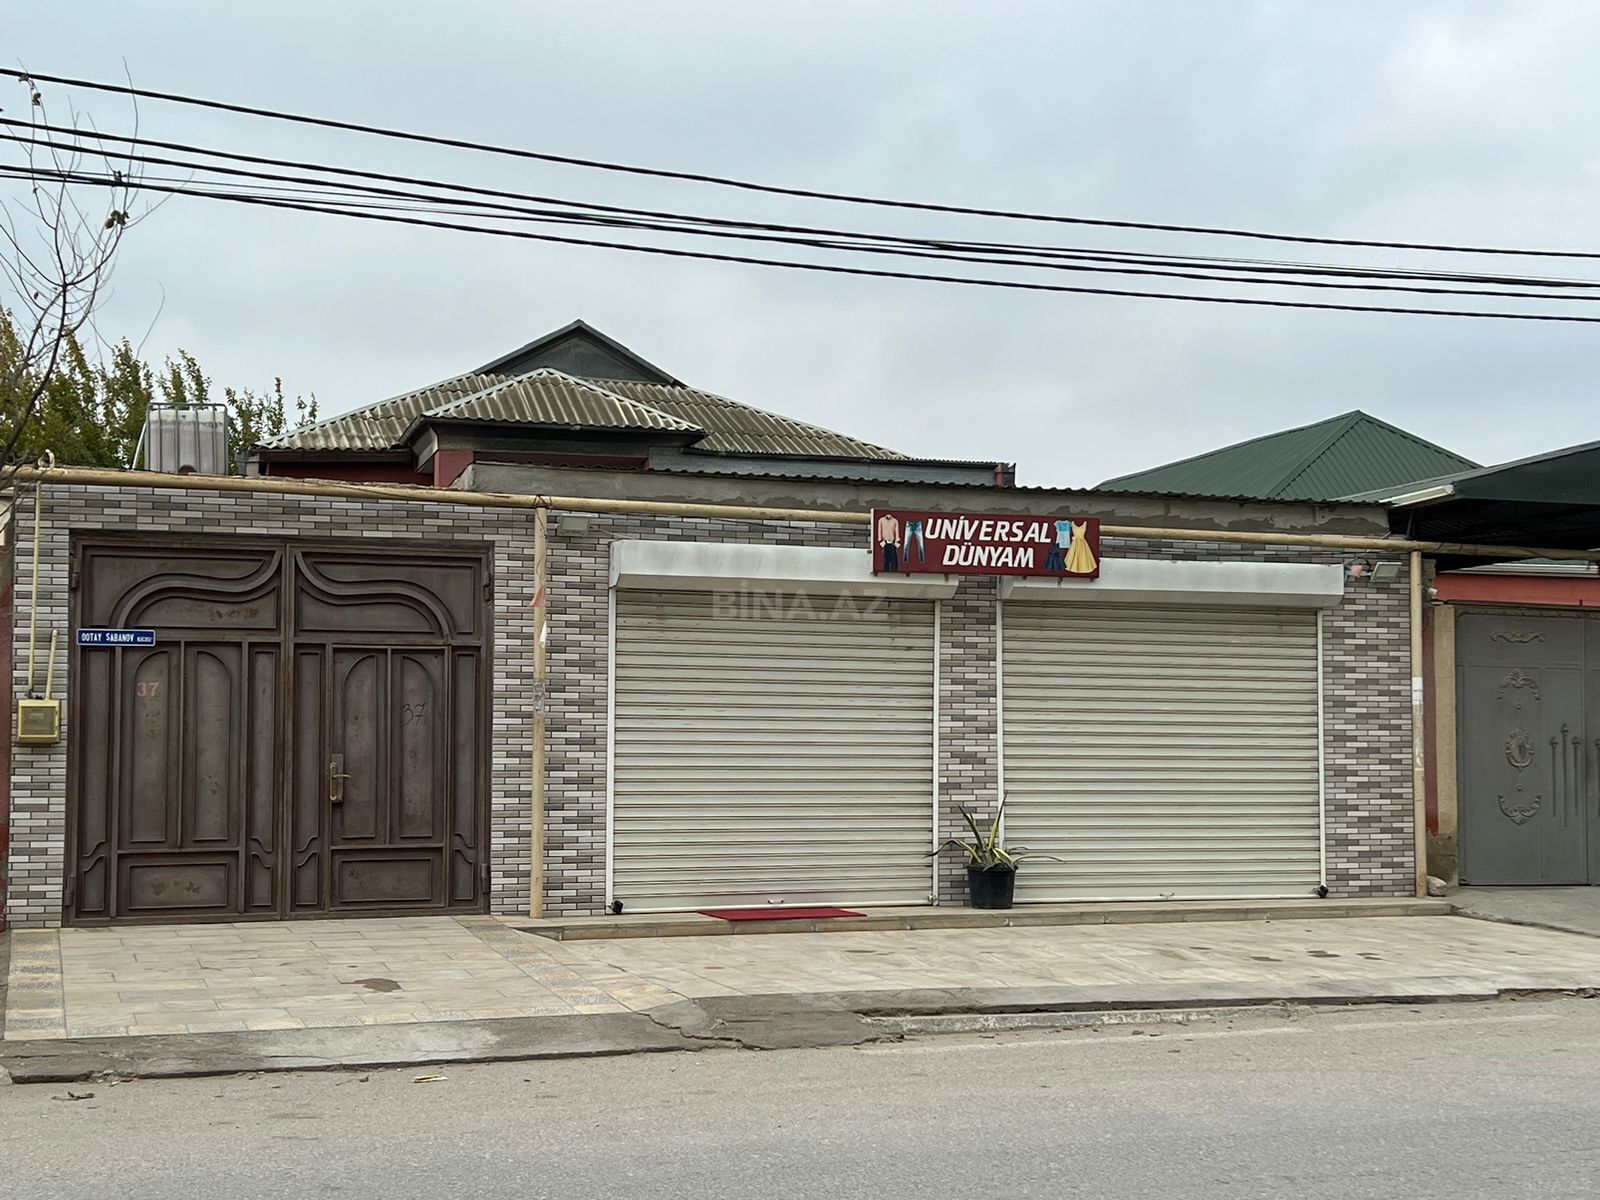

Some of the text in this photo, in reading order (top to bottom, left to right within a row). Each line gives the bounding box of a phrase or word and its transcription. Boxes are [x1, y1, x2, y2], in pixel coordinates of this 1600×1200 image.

[925, 516, 1052, 543] UNİVERSAL
[942, 542, 1034, 568] DÜNYAM
[136, 681, 160, 697] 37
[402, 702, 426, 727] 37
